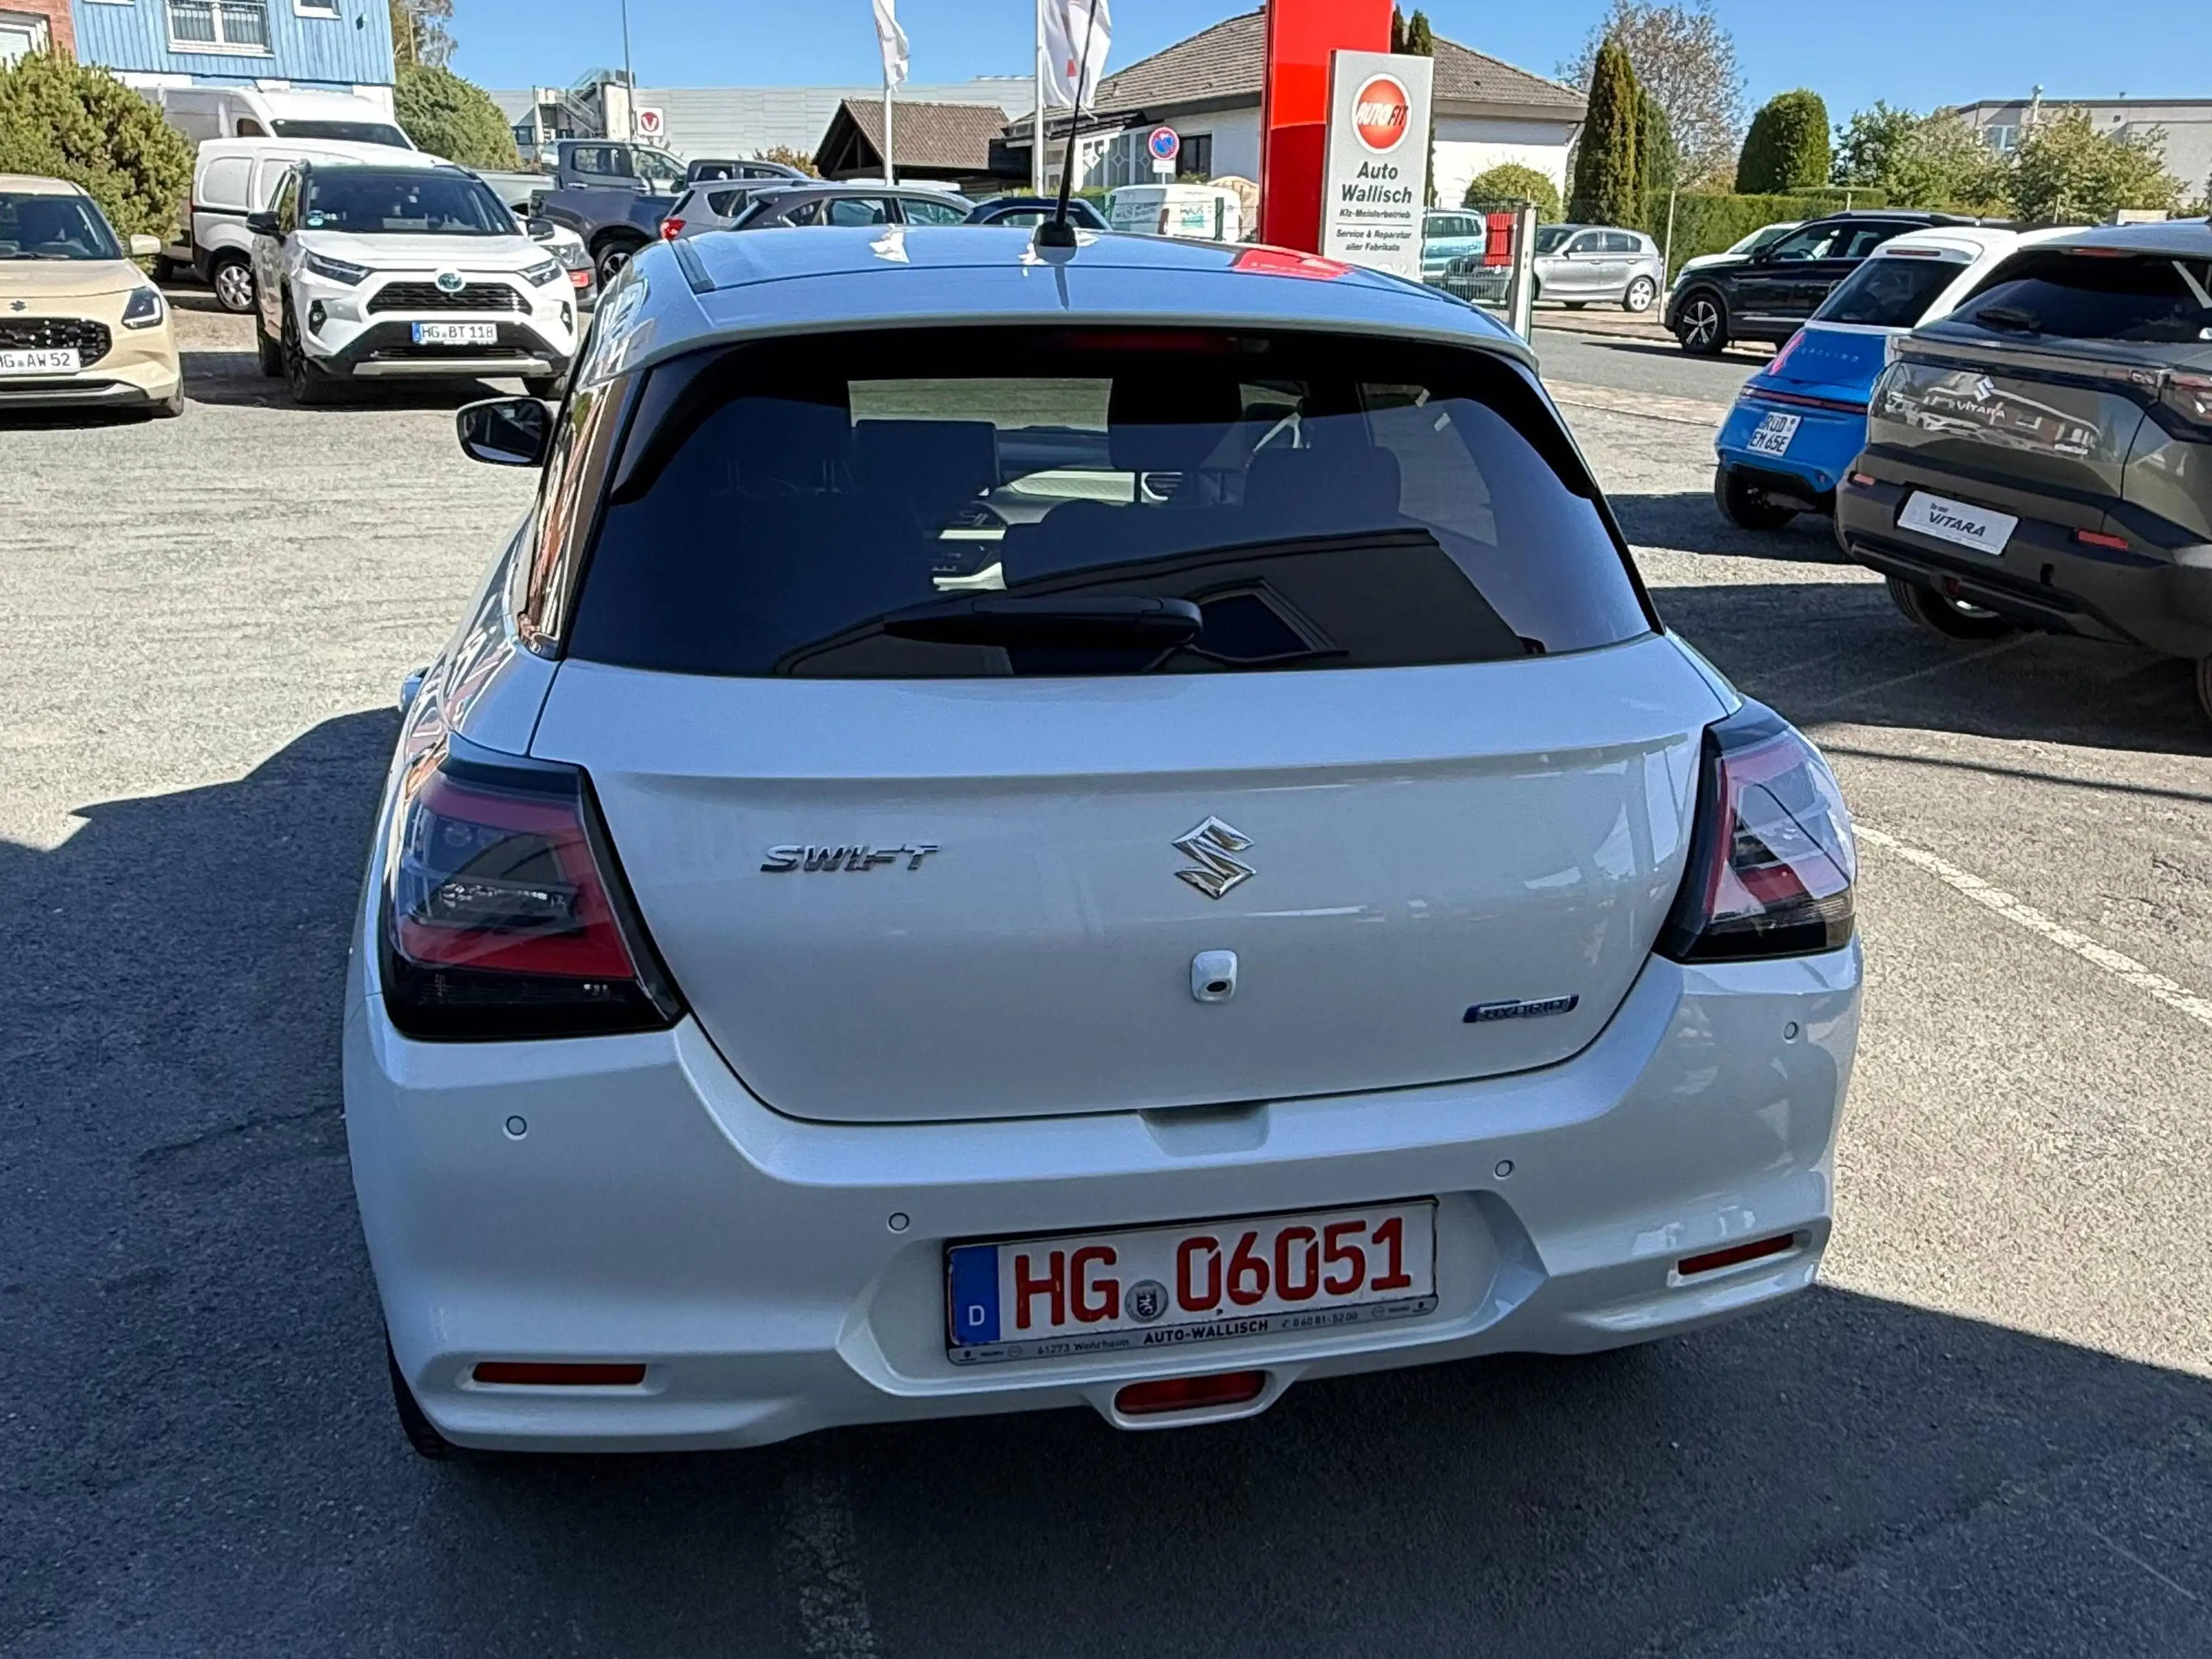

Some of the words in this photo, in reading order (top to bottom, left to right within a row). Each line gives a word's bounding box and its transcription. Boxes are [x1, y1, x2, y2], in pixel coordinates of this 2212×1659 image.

[1356, 161, 1398, 180] Auto
[1341, 184, 1412, 203] Wallisch
[1336, 229, 1364, 238] Service
[422, 326, 440, 338] HG
[449, 326, 466, 338] BT
[470, 326, 494, 338] 118
[27, 353, 46, 368] AW
[50, 352, 70, 366] 52
[1929, 512, 1986, 537] VITARA
[760, 844, 940, 872] SWIFT
[969, 1305, 985, 1325] D
[1015, 1246, 1120, 1330] HG
[1177, 1217, 1411, 1312] 06051
[1144, 1319, 1268, 1344] AUTO-WALLISCH
